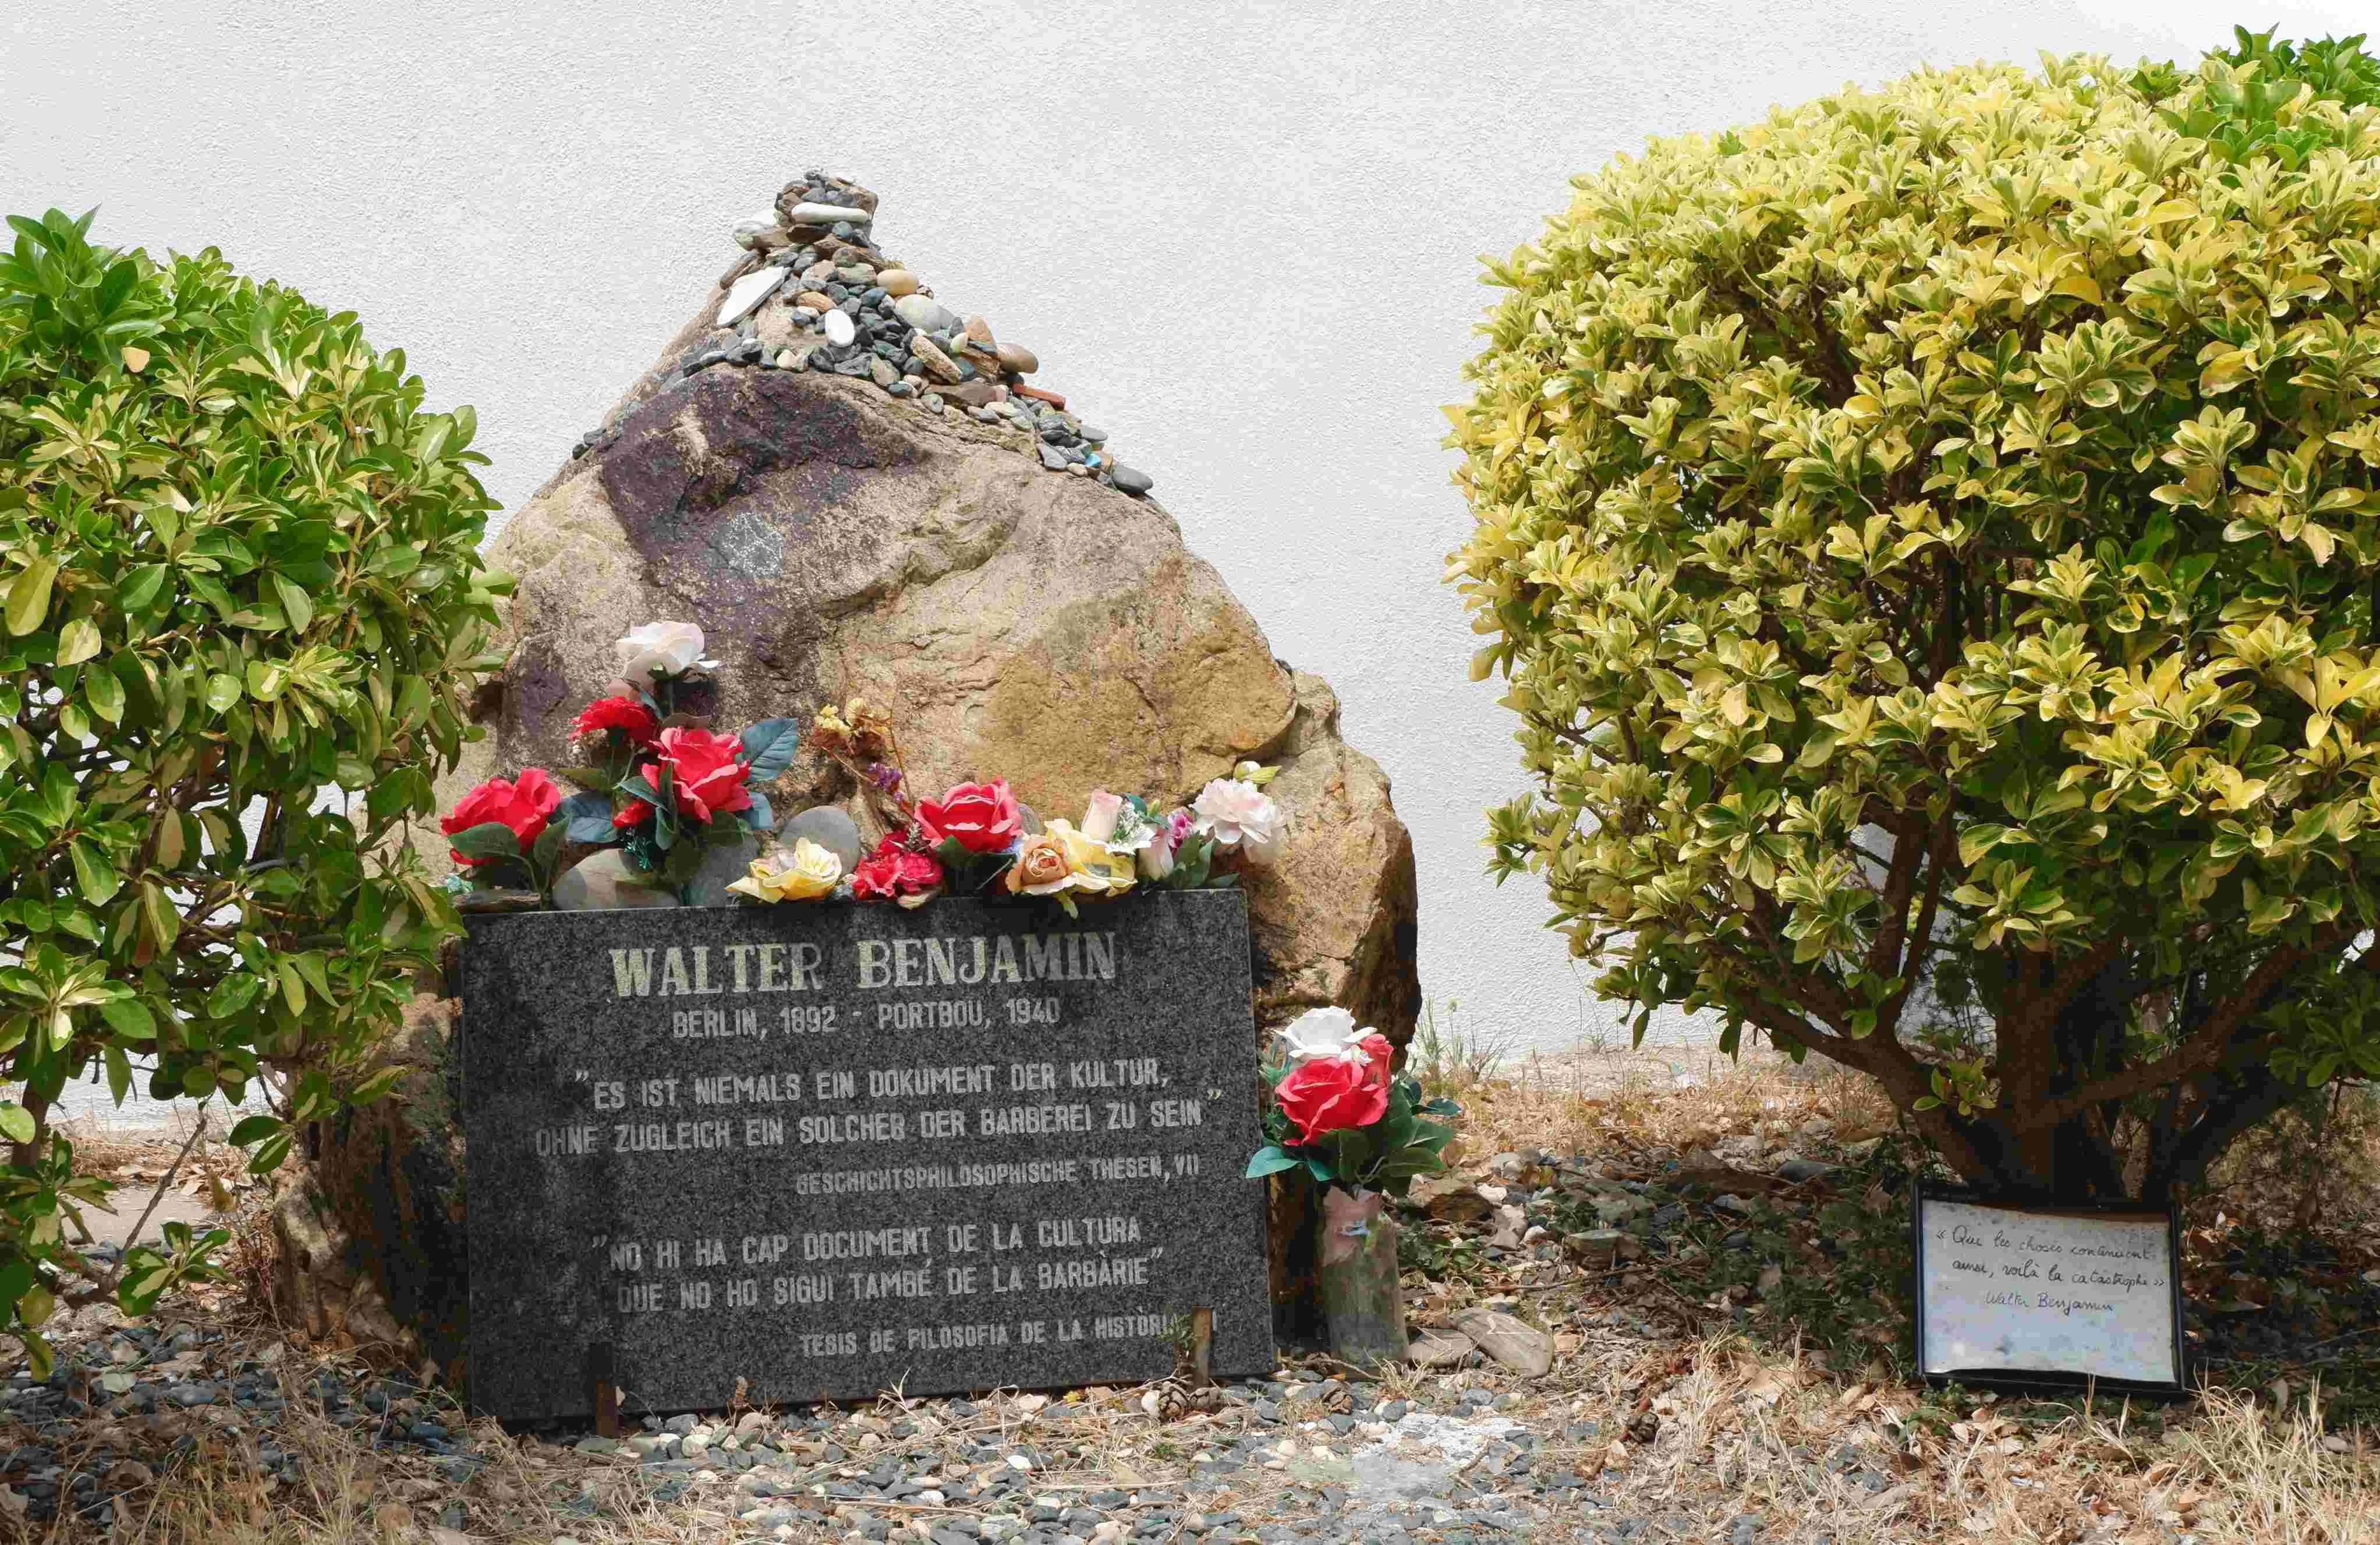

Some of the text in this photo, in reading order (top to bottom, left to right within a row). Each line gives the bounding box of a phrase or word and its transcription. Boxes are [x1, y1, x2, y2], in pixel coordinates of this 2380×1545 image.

[608, 932, 1115, 997] WALTER BENJAMIN
[673, 1007, 767, 1040] BERLIN,
[780, 1006, 838, 1034] 1892
[879, 1000, 990, 1030] PORTBOU,
[1005, 997, 1060, 1024] 1940
[642, 1079, 680, 1106] IST
[694, 1073, 802, 1104] NIEMALS
[816, 1070, 855, 1100] EIN
[869, 1065, 996, 1097] DOKUMENT
[1010, 1063, 1057, 1091] DER
[1070, 1058, 1169, 1088] KULTUR,
[536, 1125, 599, 1157] OHNE
[614, 1120, 731, 1153] ZUGLEICH
[745, 1117, 784, 1147] EIN
[920, 1109, 965, 1138] DER
[1107, 1100, 1137, 1130] ZU
[796, 1159, 1077, 1194] GESCHICHTSPHILOSOPHISCHE
[657, 1239, 680, 1268] HI
[696, 1238, 727, 1267] HA
[742, 1235, 788, 1264] CAP
[804, 1226, 932, 1261] DOCUMENT
[947, 1224, 978, 1253] DE
[993, 1222, 1023, 1250] LA
[1037, 1216, 1142, 1248] CULTURA
[1952, 1224, 1983, 1247] Que
[1993, 1229, 2011, 1248] les
[2019, 1233, 2063, 1253] choses
[680, 1281, 711, 1310] NO
[727, 1278, 757, 1307] HO
[773, 1275, 834, 1304] SIGUI
[848, 1258, 932, 1300] TAMBÉ
[947, 1266, 978, 1295] DE
[992, 1265, 1023, 1293] LA
[2002, 1258, 2041, 1278] voilà
[2048, 1264, 2063, 1282] la
[2071, 1268, 2148, 1293] catastrophe
[1984, 1290, 2113, 1316] Walter Benjamin
[799, 1305, 1175, 1356] TESIS DE FILOSOFIA DE LA HISTÒRI
